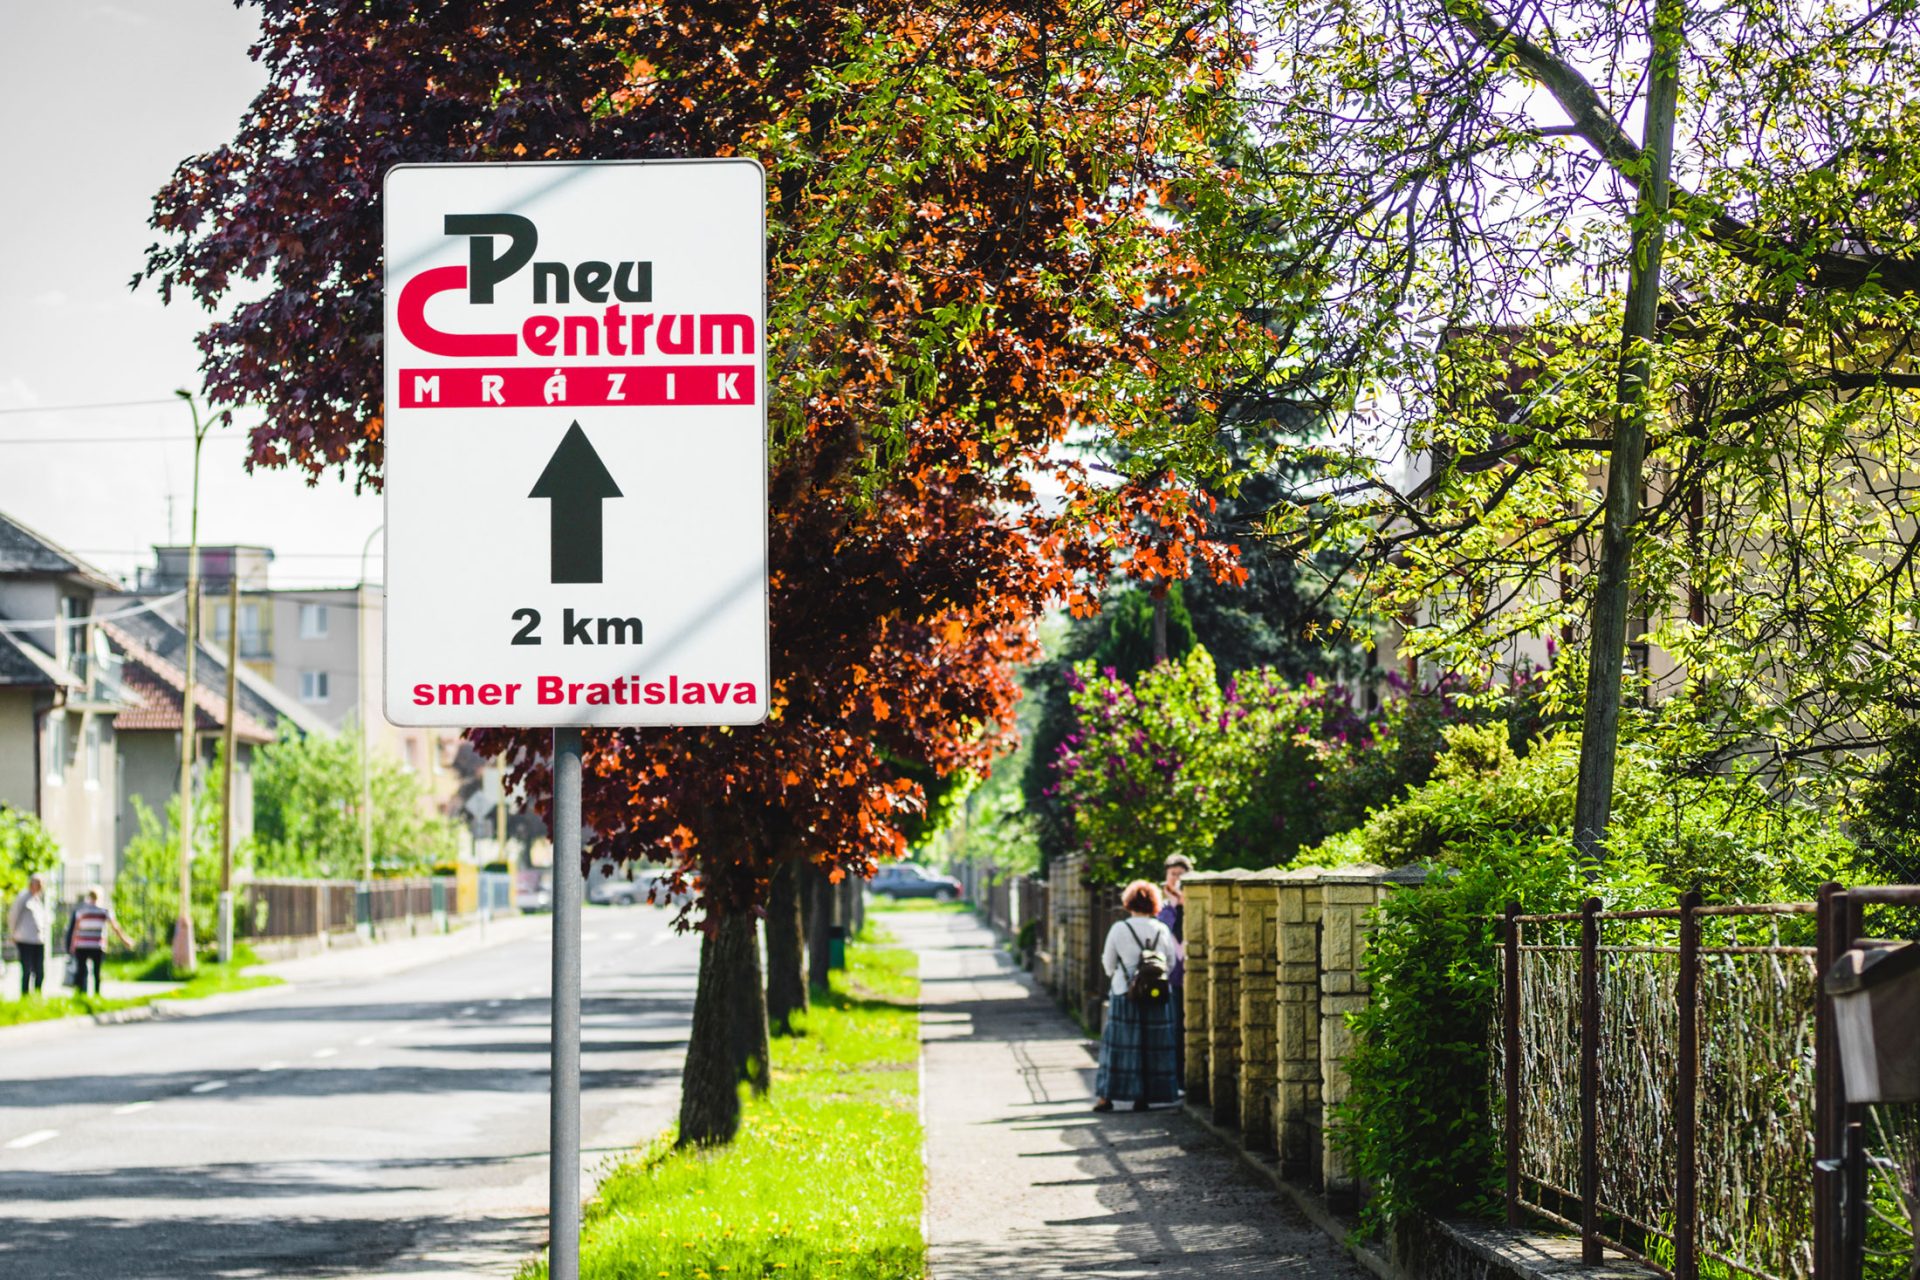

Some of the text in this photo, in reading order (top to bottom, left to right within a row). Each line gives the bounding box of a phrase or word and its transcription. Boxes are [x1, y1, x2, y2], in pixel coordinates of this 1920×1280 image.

[444, 213, 653, 305] Pneu
[397, 264, 755, 357] Centrum
[510, 608, 643, 646] 2 km
[412, 674, 757, 706] smer Bratislava
